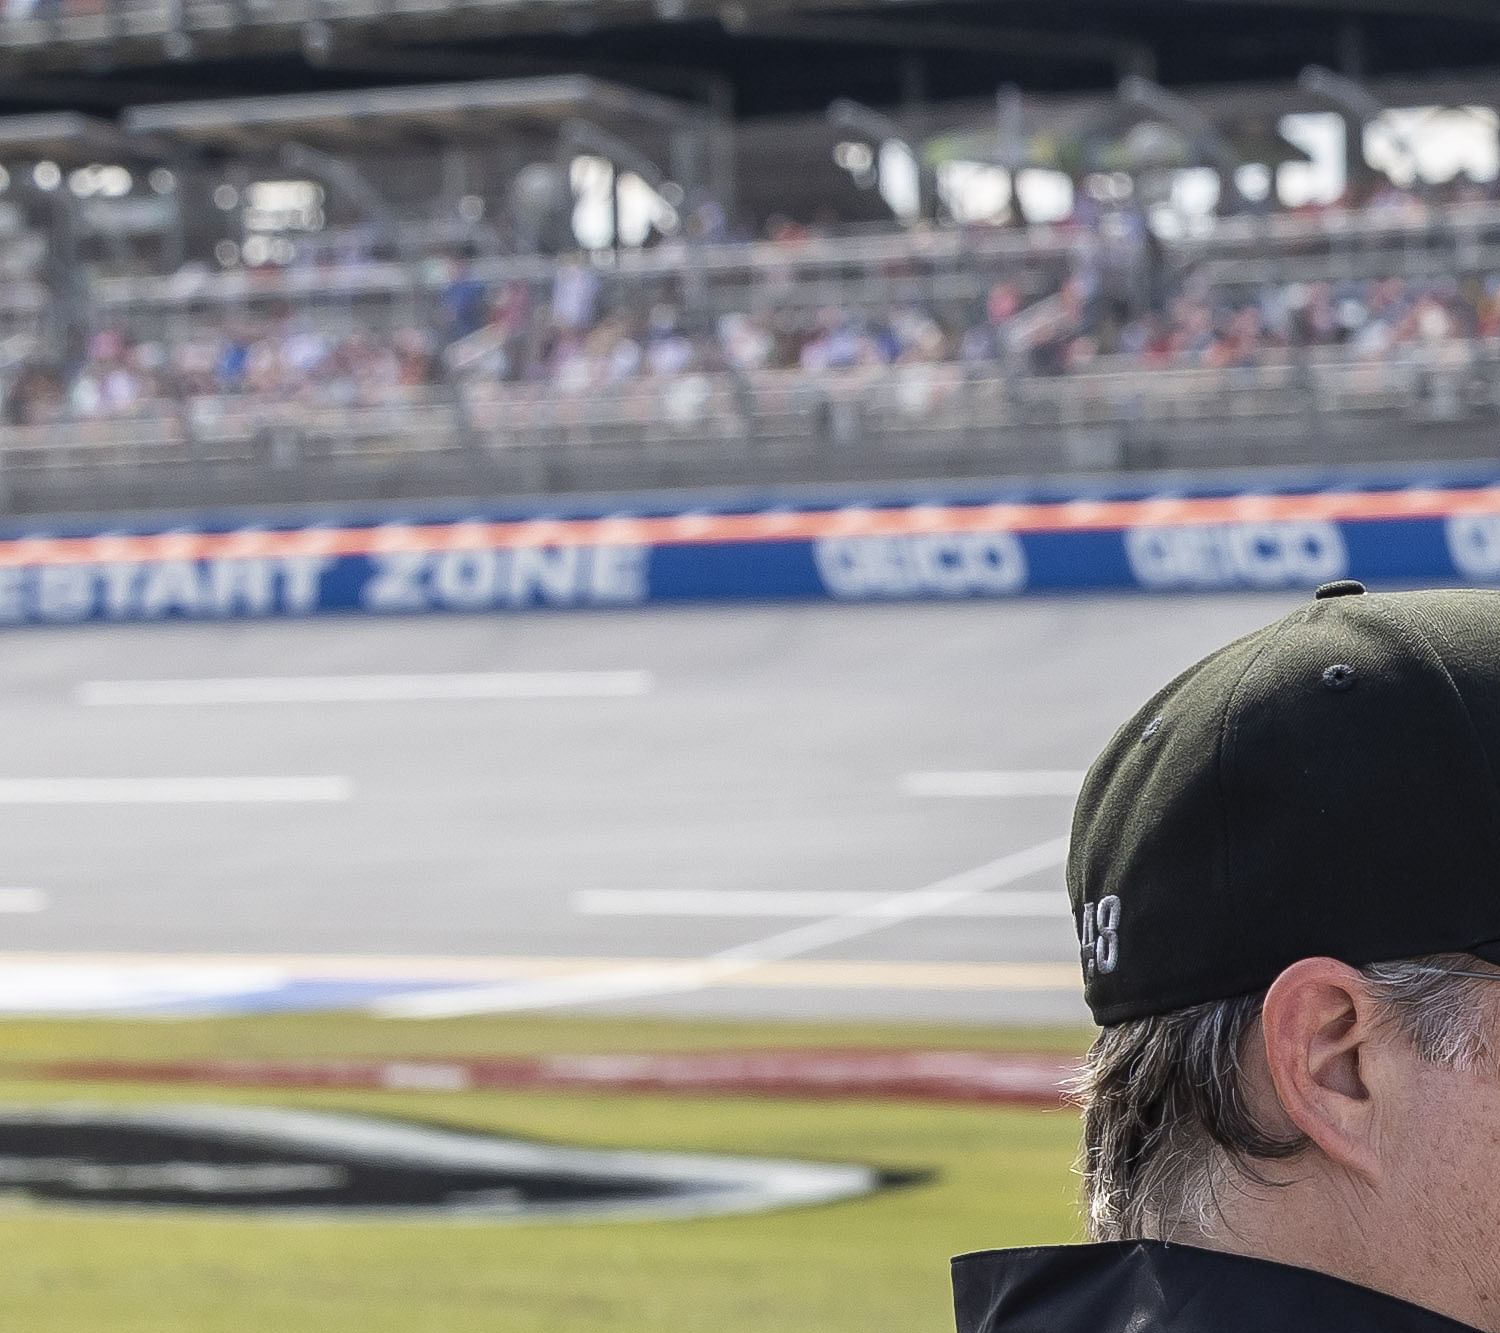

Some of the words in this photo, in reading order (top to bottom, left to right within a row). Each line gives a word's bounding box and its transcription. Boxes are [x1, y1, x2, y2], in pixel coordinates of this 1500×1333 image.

[363, 545, 647, 612] ZONE
[814, 531, 1029, 599] GEICO
[1125, 519, 1349, 586] GEICO
